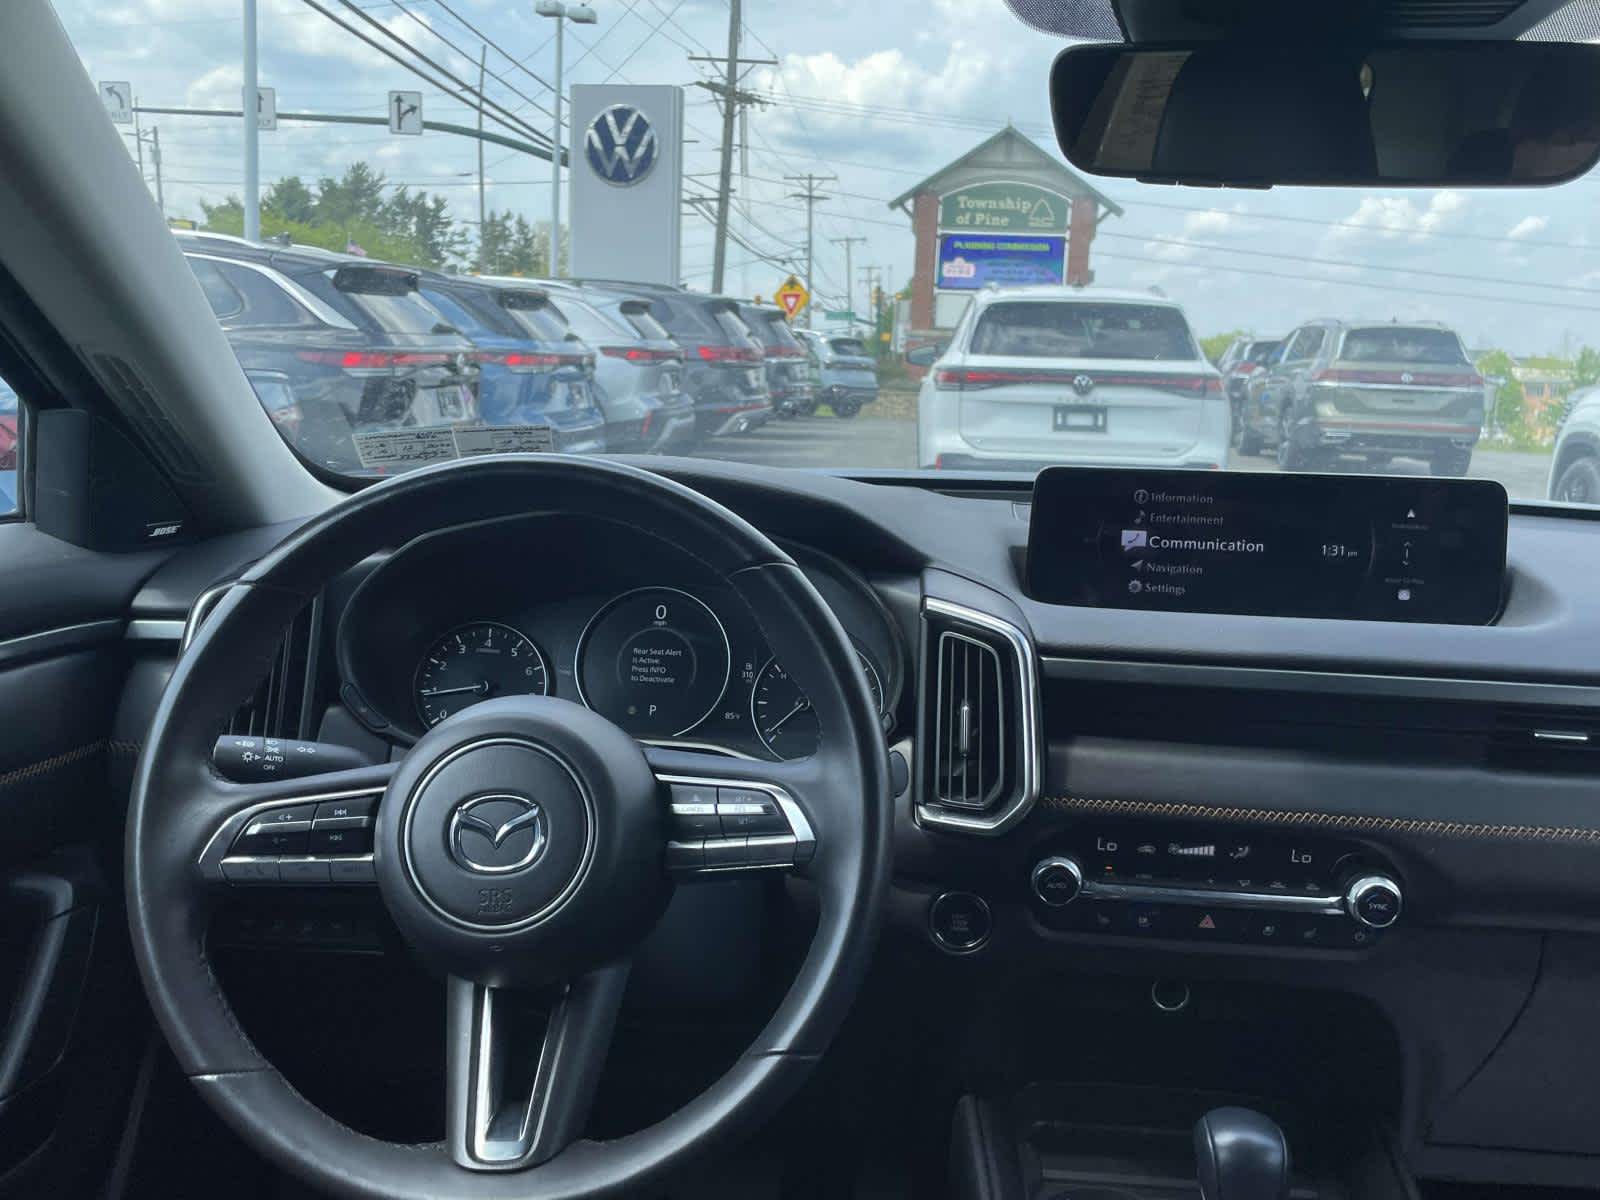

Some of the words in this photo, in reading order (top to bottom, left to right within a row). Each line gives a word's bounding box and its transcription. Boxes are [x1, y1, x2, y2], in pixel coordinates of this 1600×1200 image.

[957, 195, 1032, 214] Township
[955, 212, 971, 225] of
[975, 213, 1010, 226] Pine
[1151, 492, 1214, 504] Information
[1149, 511, 1224, 526] Entertainment
[149, 525, 181, 537] BOSE
[1149, 535, 1265, 552] Communication
[1321, 543, 1346, 557] 1:31
[1146, 562, 1203, 576] Navigation
[1144, 582, 1186, 596] Settings
[655, 604, 668, 620] 0
[633, 648, 648, 656] Rear
[649, 648, 664, 656] Seat
[665, 649, 682, 657] Alert
[264, 755, 284, 763] AUTO
